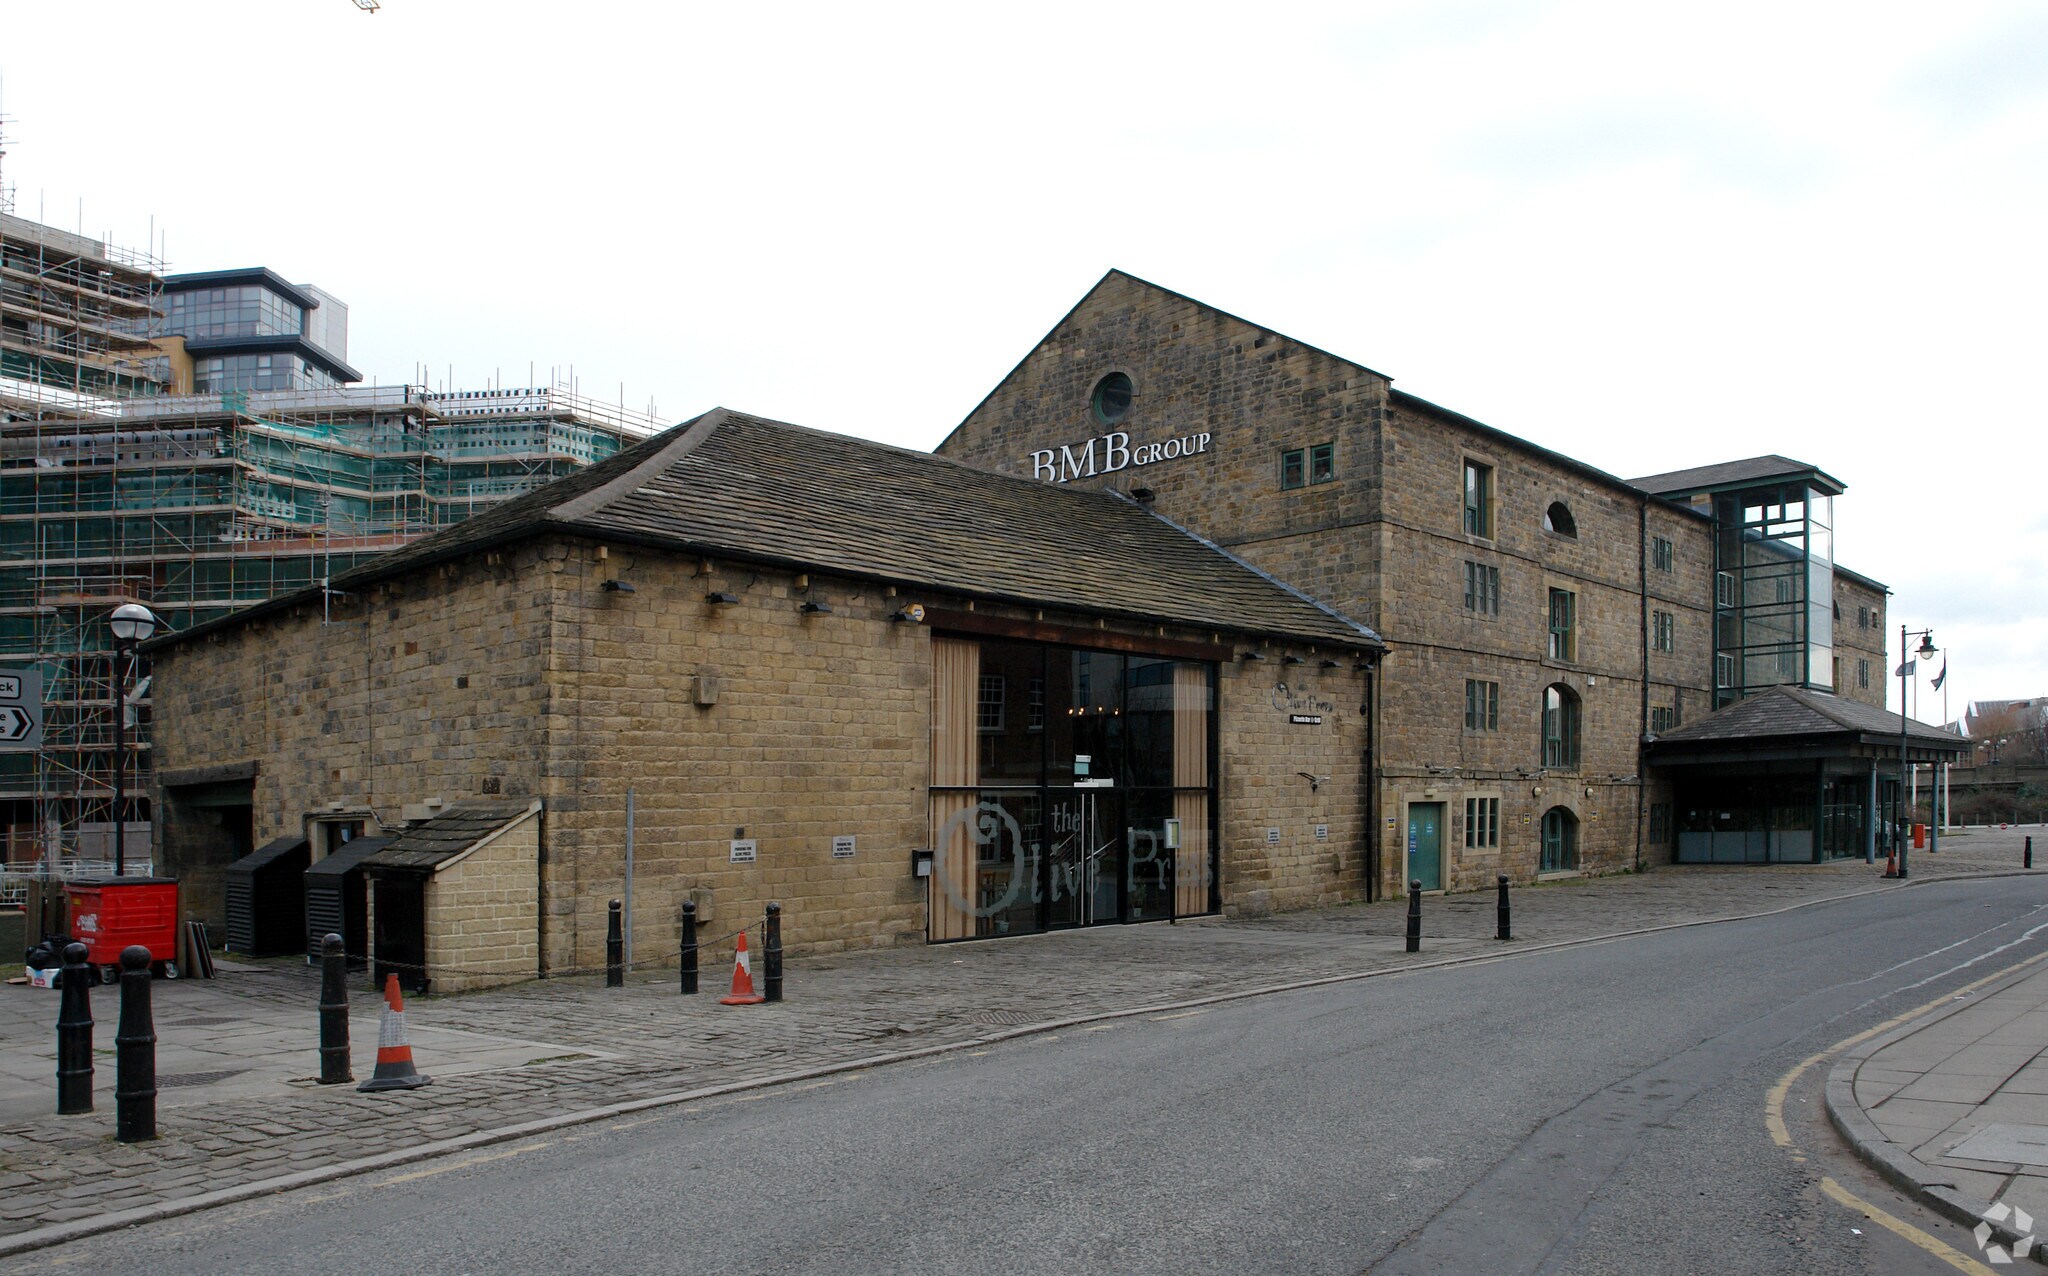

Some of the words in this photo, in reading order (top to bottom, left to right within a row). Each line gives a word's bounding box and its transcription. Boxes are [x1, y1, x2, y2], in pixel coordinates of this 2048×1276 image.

[1030, 432, 1130, 483] BMB
[1133, 432, 1211, 466] GROUP
[1051, 802, 1082, 833] the
